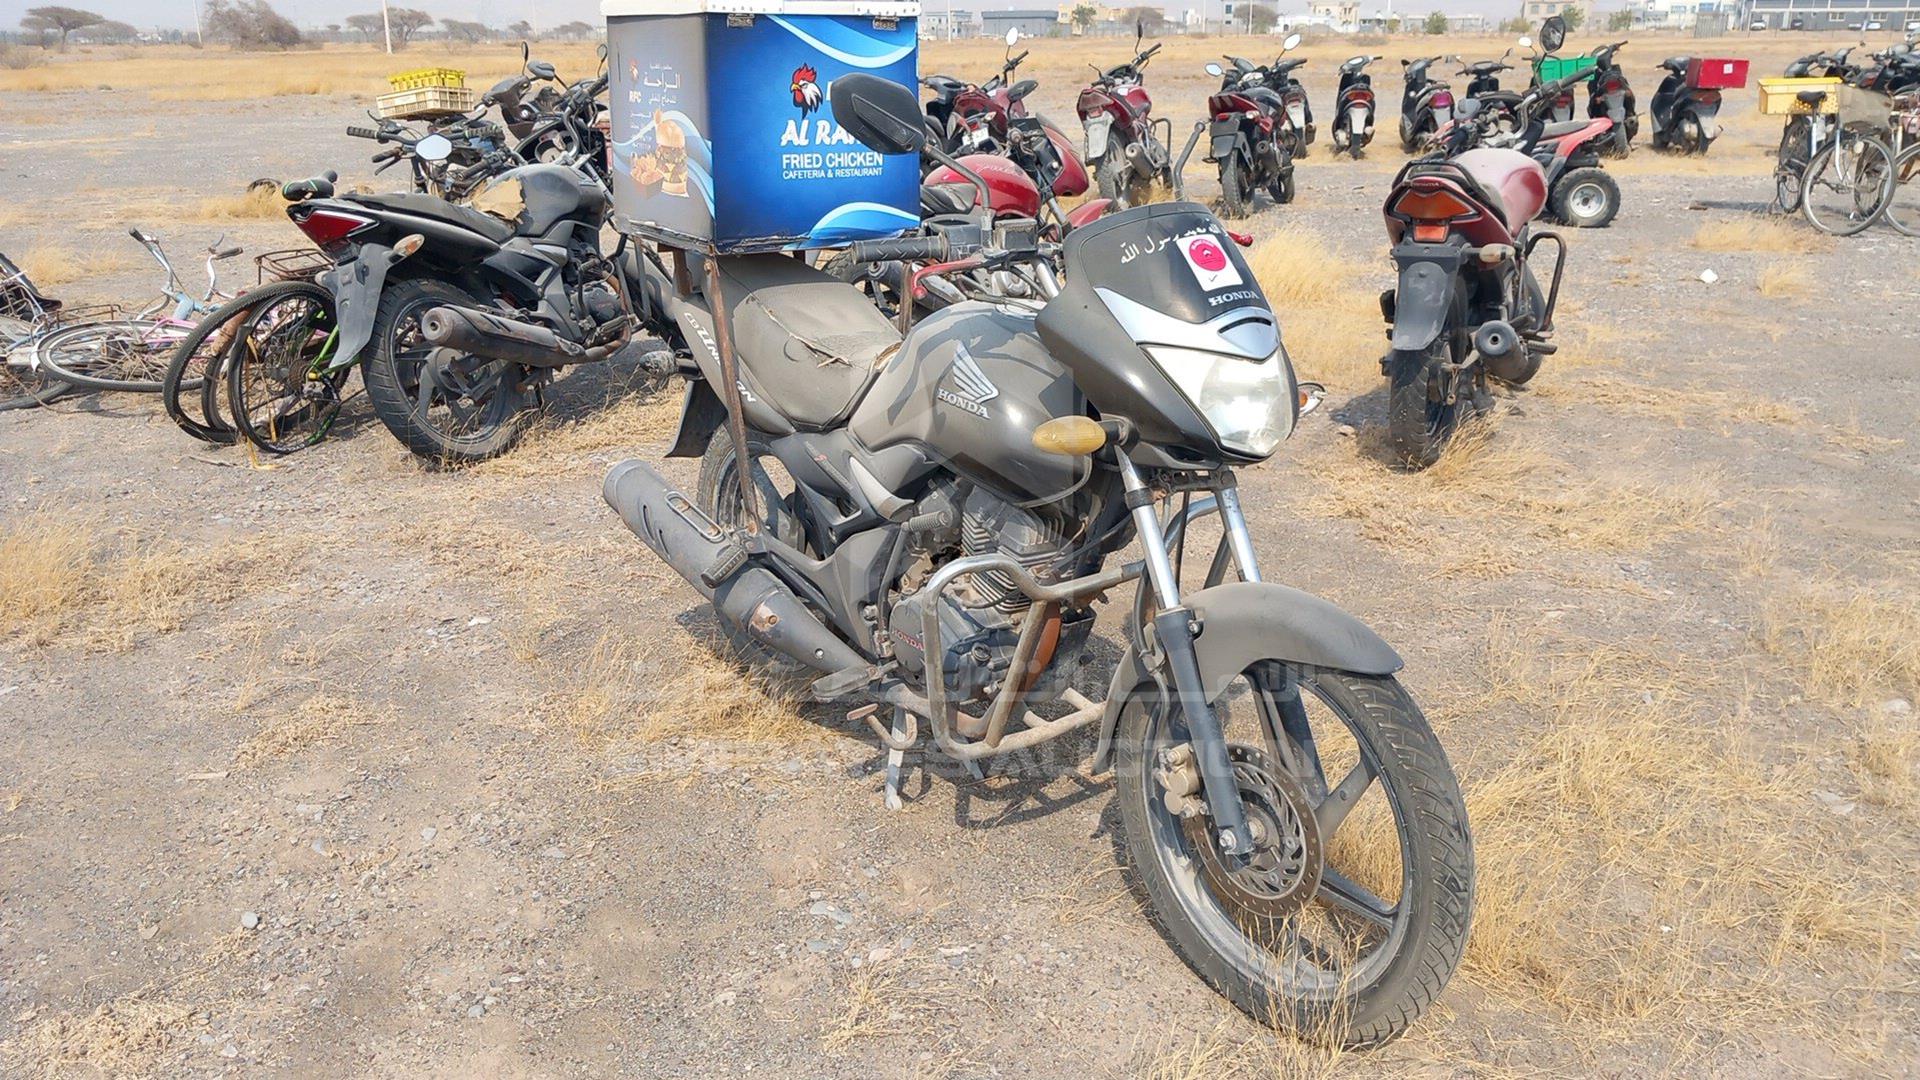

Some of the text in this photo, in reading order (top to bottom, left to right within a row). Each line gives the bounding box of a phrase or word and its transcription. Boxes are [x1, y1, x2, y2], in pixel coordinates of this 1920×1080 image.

[780, 119, 809, 146] AL
[782, 151, 883, 169] FRIED CHICKEN
[782, 166, 883, 180] CAFETERIA & RESTAURANT
[1208, 291, 1260, 306] HONDA
[938, 387, 991, 419] HONDA
